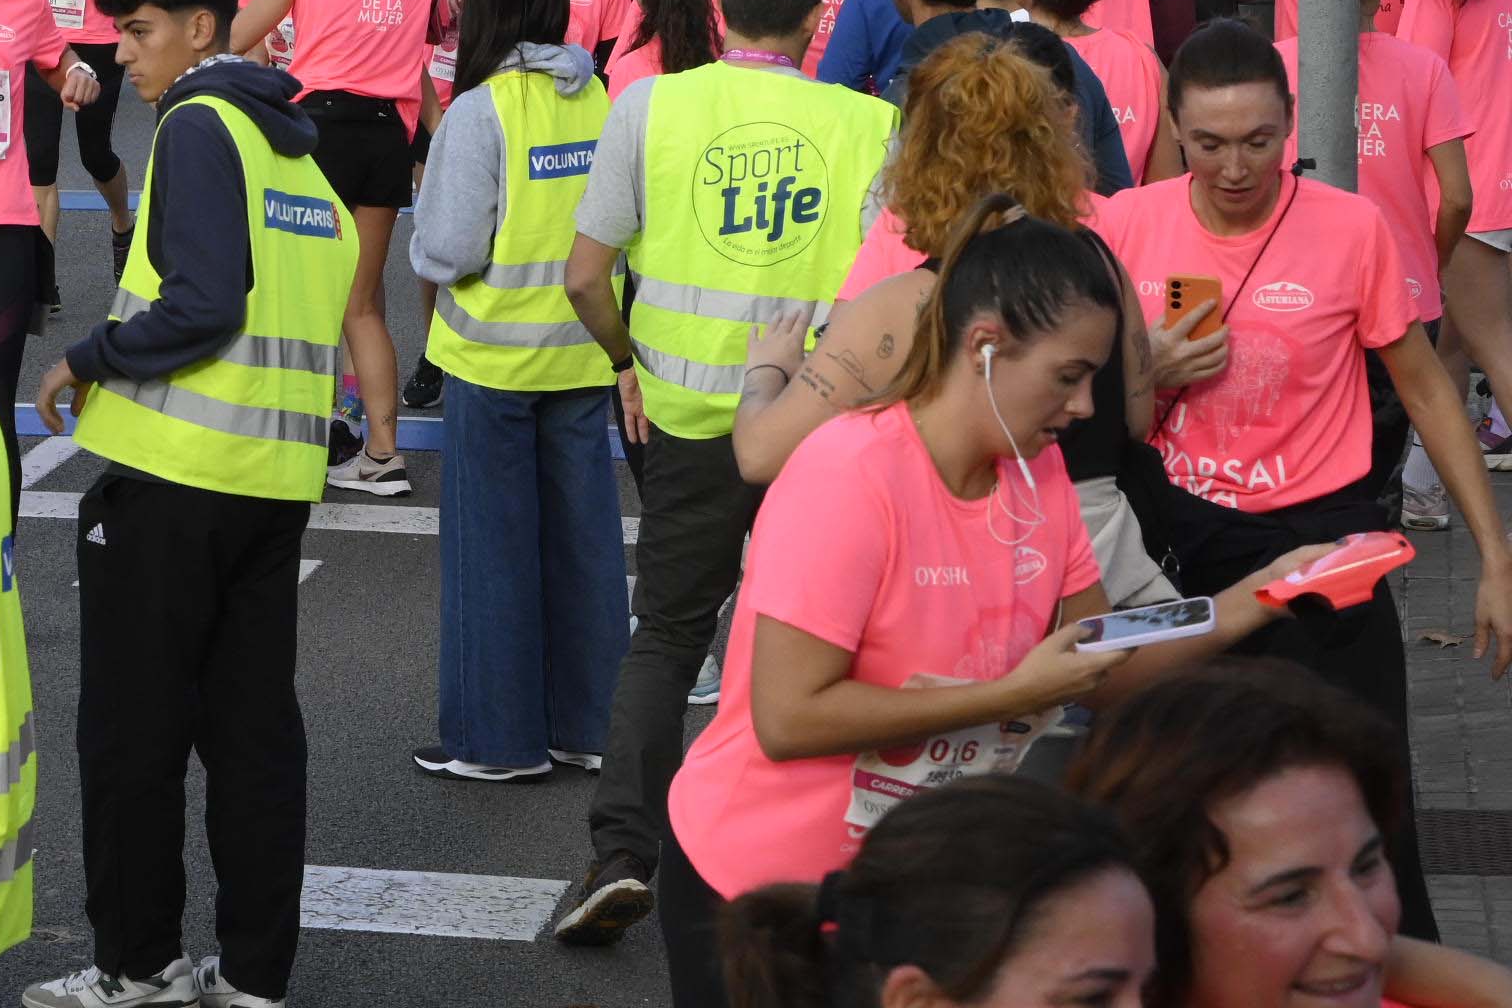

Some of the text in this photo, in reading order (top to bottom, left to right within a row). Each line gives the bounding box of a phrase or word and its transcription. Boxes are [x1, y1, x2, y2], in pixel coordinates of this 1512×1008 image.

[358, 9, 403, 25] MUJER
[531, 150, 593, 171] VOLUNTA
[704, 139, 805, 189] Sport
[719, 176, 821, 242] Life
[1257, 290, 1310, 305] ASTURIANA
[930, 739, 979, 764] 016
[871, 779, 914, 797] CARRER
